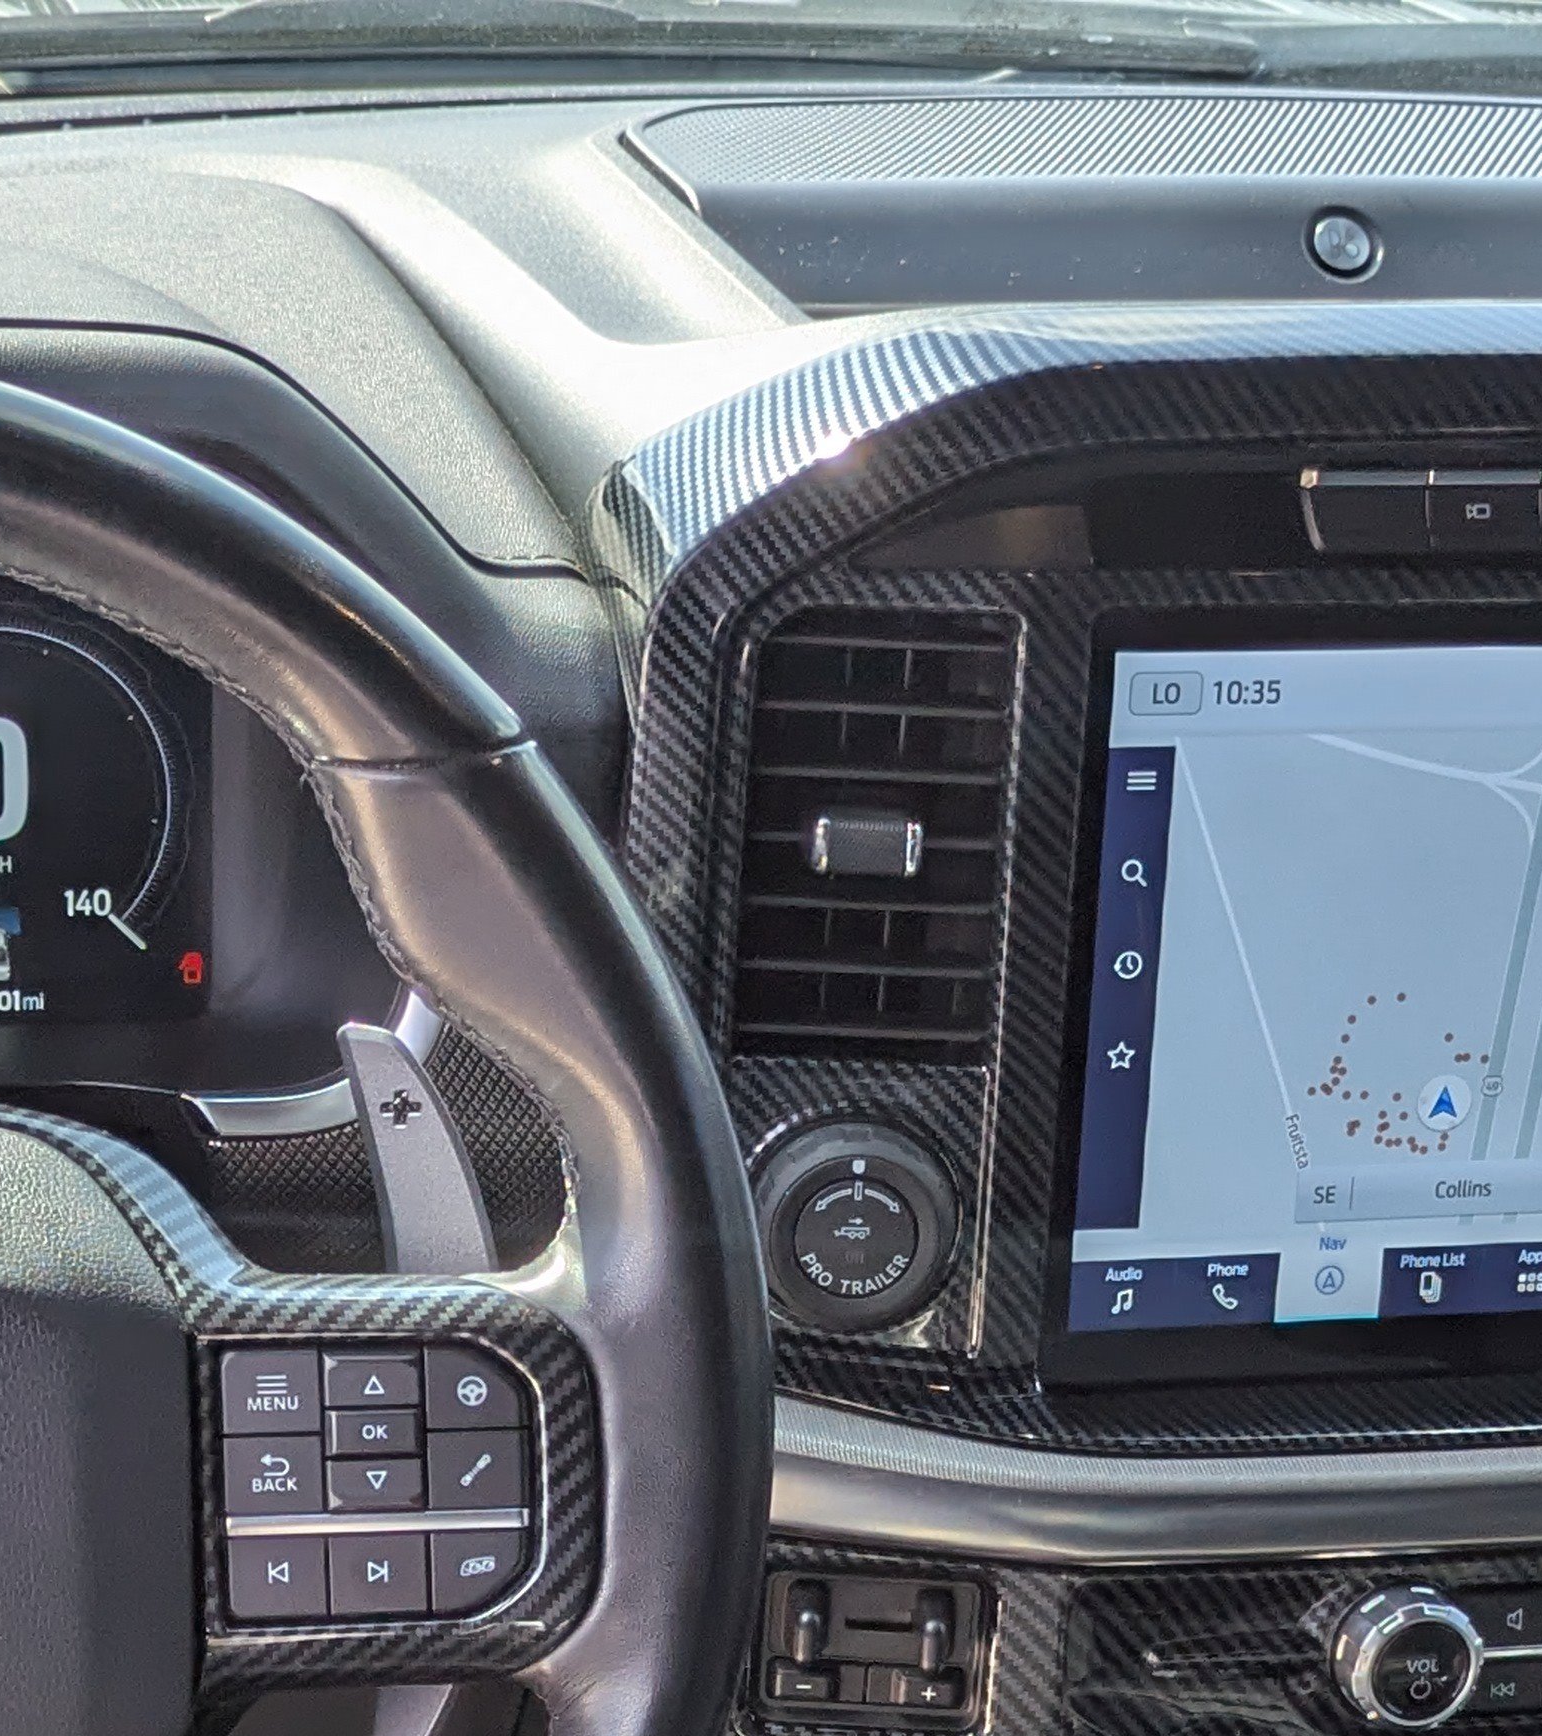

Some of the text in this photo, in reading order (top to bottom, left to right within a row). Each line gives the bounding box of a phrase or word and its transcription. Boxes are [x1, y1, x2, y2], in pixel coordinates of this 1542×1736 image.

[1151, 682, 1181, 704] LO
[1212, 680, 1281, 705] 10:35
[64, 888, 112, 918] 140
[1313, 1185, 1337, 1204] SE
[1434, 1179, 1492, 1200] Collins
[1319, 1236, 1347, 1253] Nav
[1400, 1251, 1466, 1270] Phone List
[800, 1253, 910, 1295] PRO TRAILER
[1105, 1266, 1143, 1283] Audio
[1207, 1262, 1249, 1278] Phone
[247, 1396, 299, 1412] MENU
[361, 1424, 388, 1440] OK
[252, 1477, 298, 1493] BACK
[1406, 1658, 1439, 1674] VOL
